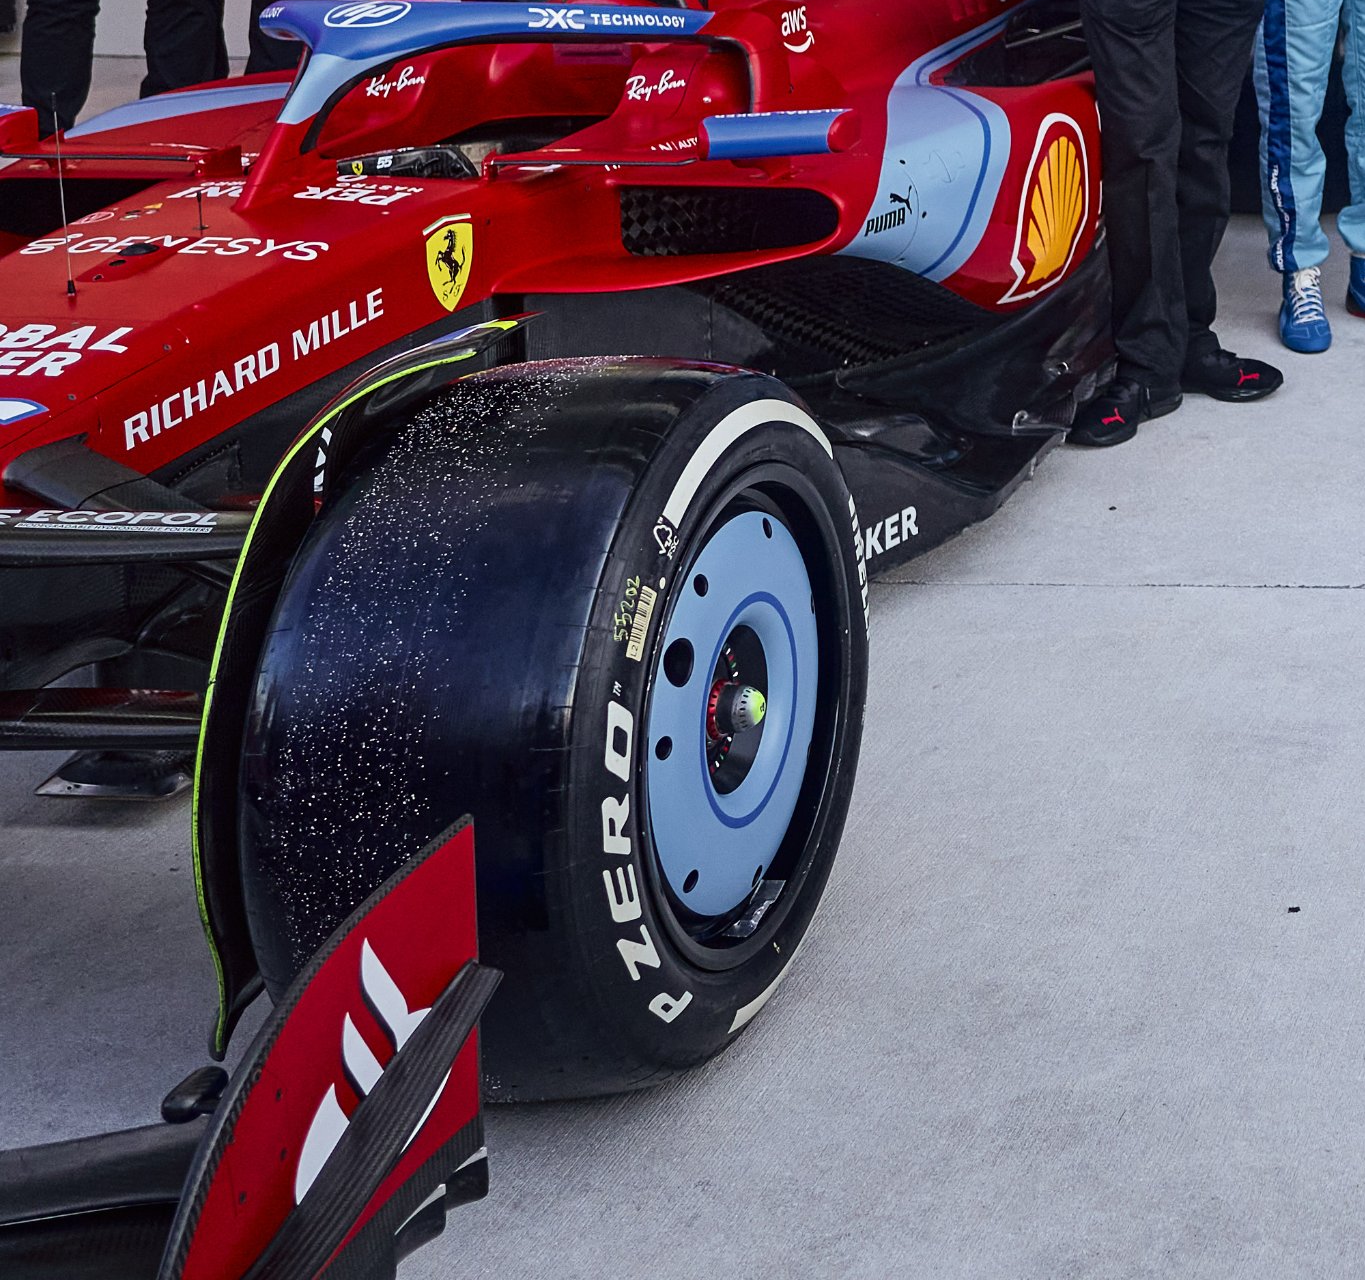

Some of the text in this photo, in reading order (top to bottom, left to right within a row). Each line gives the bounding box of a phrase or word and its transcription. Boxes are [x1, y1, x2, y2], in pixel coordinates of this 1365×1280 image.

[527, 7, 686, 30] DXC TECHNOLOGY
[780, 5, 808, 37] aws
[376, 154, 394, 170] 55
[864, 207, 906, 238] PUMA
[67, 235, 330, 261] GENESYS
[0, 324, 130, 355] BAL
[123, 287, 385, 451] RICHARD MILLE
[24, 509, 218, 526] ECOPOL
[864, 505, 920, 561] KER
[602, 700, 662, 982] ZERO
